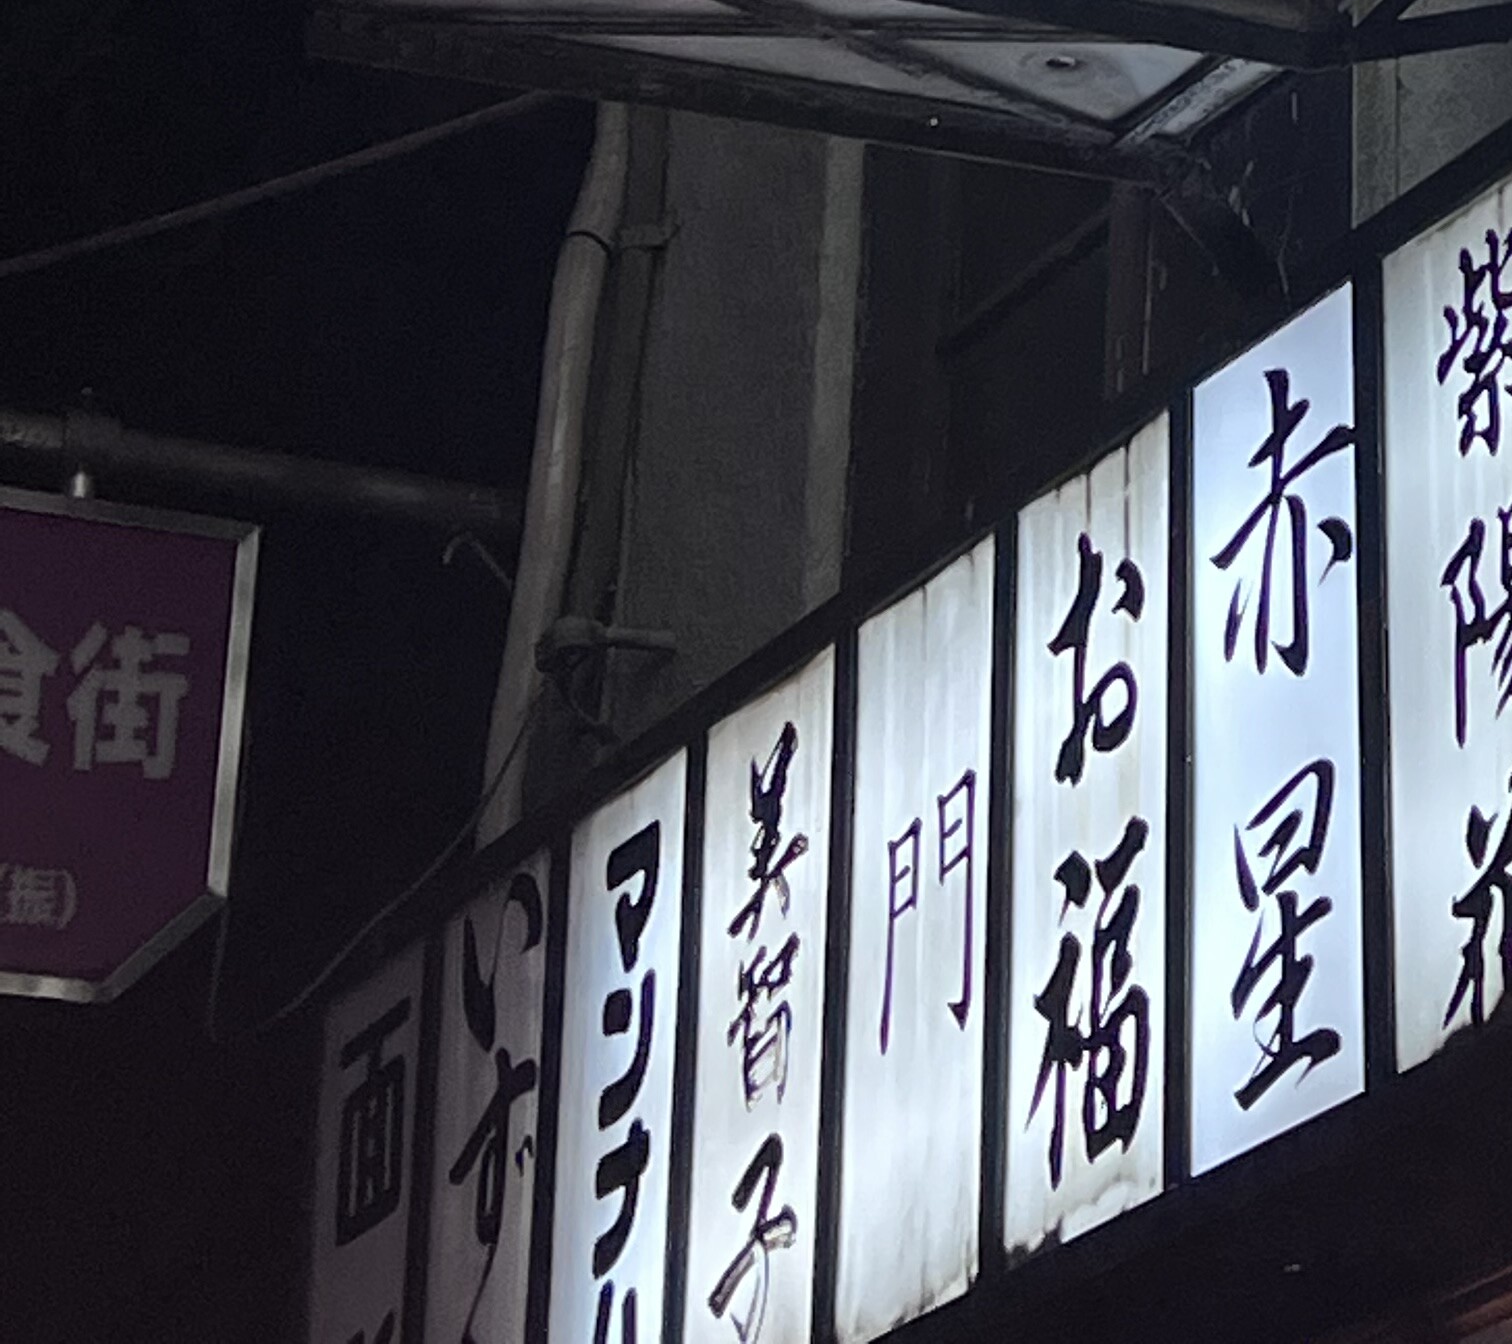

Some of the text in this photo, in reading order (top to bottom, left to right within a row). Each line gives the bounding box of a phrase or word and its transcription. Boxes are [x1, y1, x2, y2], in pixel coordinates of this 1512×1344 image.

[878, 768, 979, 1054] 門
[1024, 534, 1150, 1192] お福
[1212, 368, 1354, 1110] 赤星
[331, 996, 412, 1344] 面
[448, 870, 544, 1344] いず
